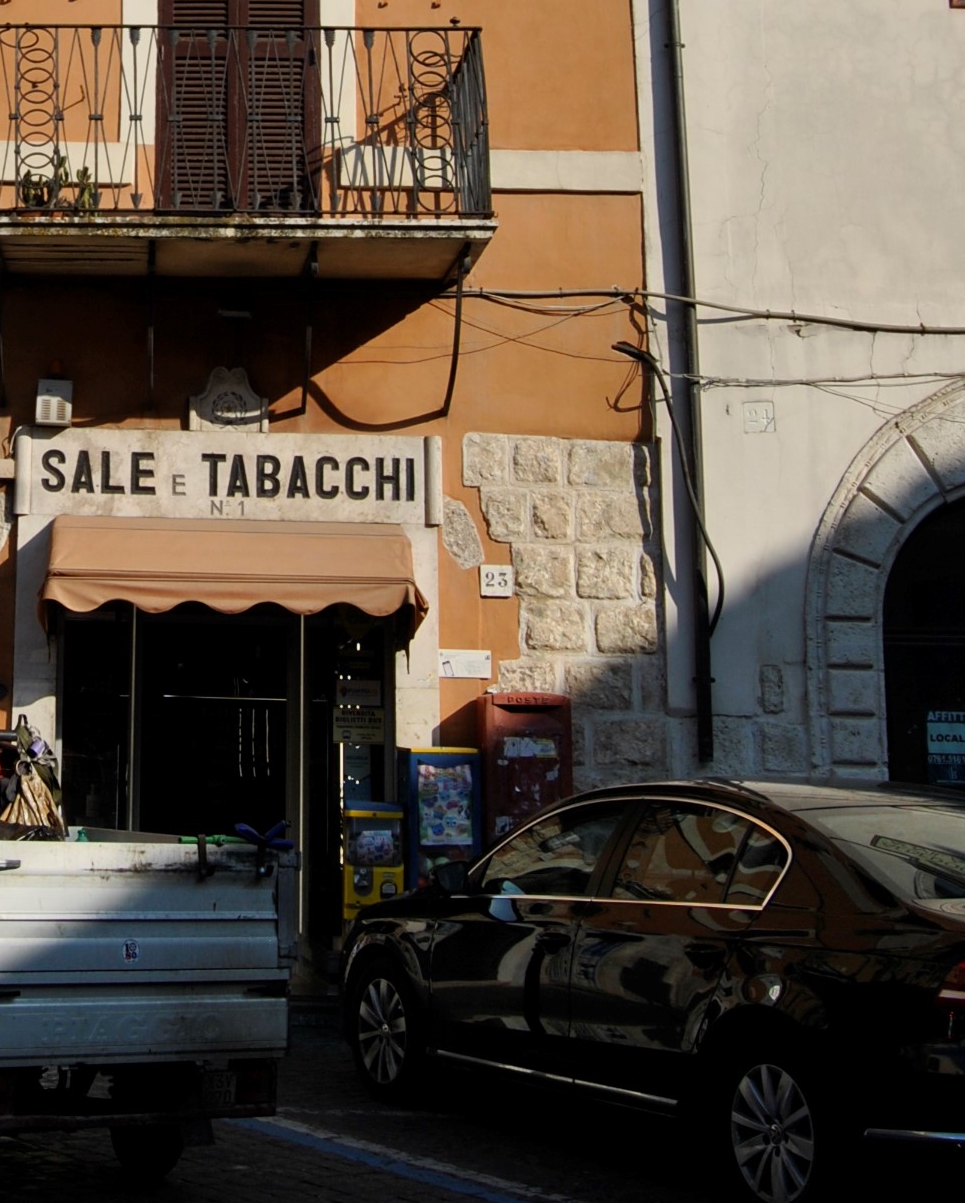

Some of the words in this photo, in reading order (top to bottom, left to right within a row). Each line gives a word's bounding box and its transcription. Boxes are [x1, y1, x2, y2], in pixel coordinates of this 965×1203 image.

[40, 448, 157, 496] SALE
[172, 474, 186, 497] E
[201, 452, 416, 503] TABACCHI
[238, 500, 245, 516] 1
[485, 571, 508, 587] 23
[507, 696, 550, 704] POSTE
